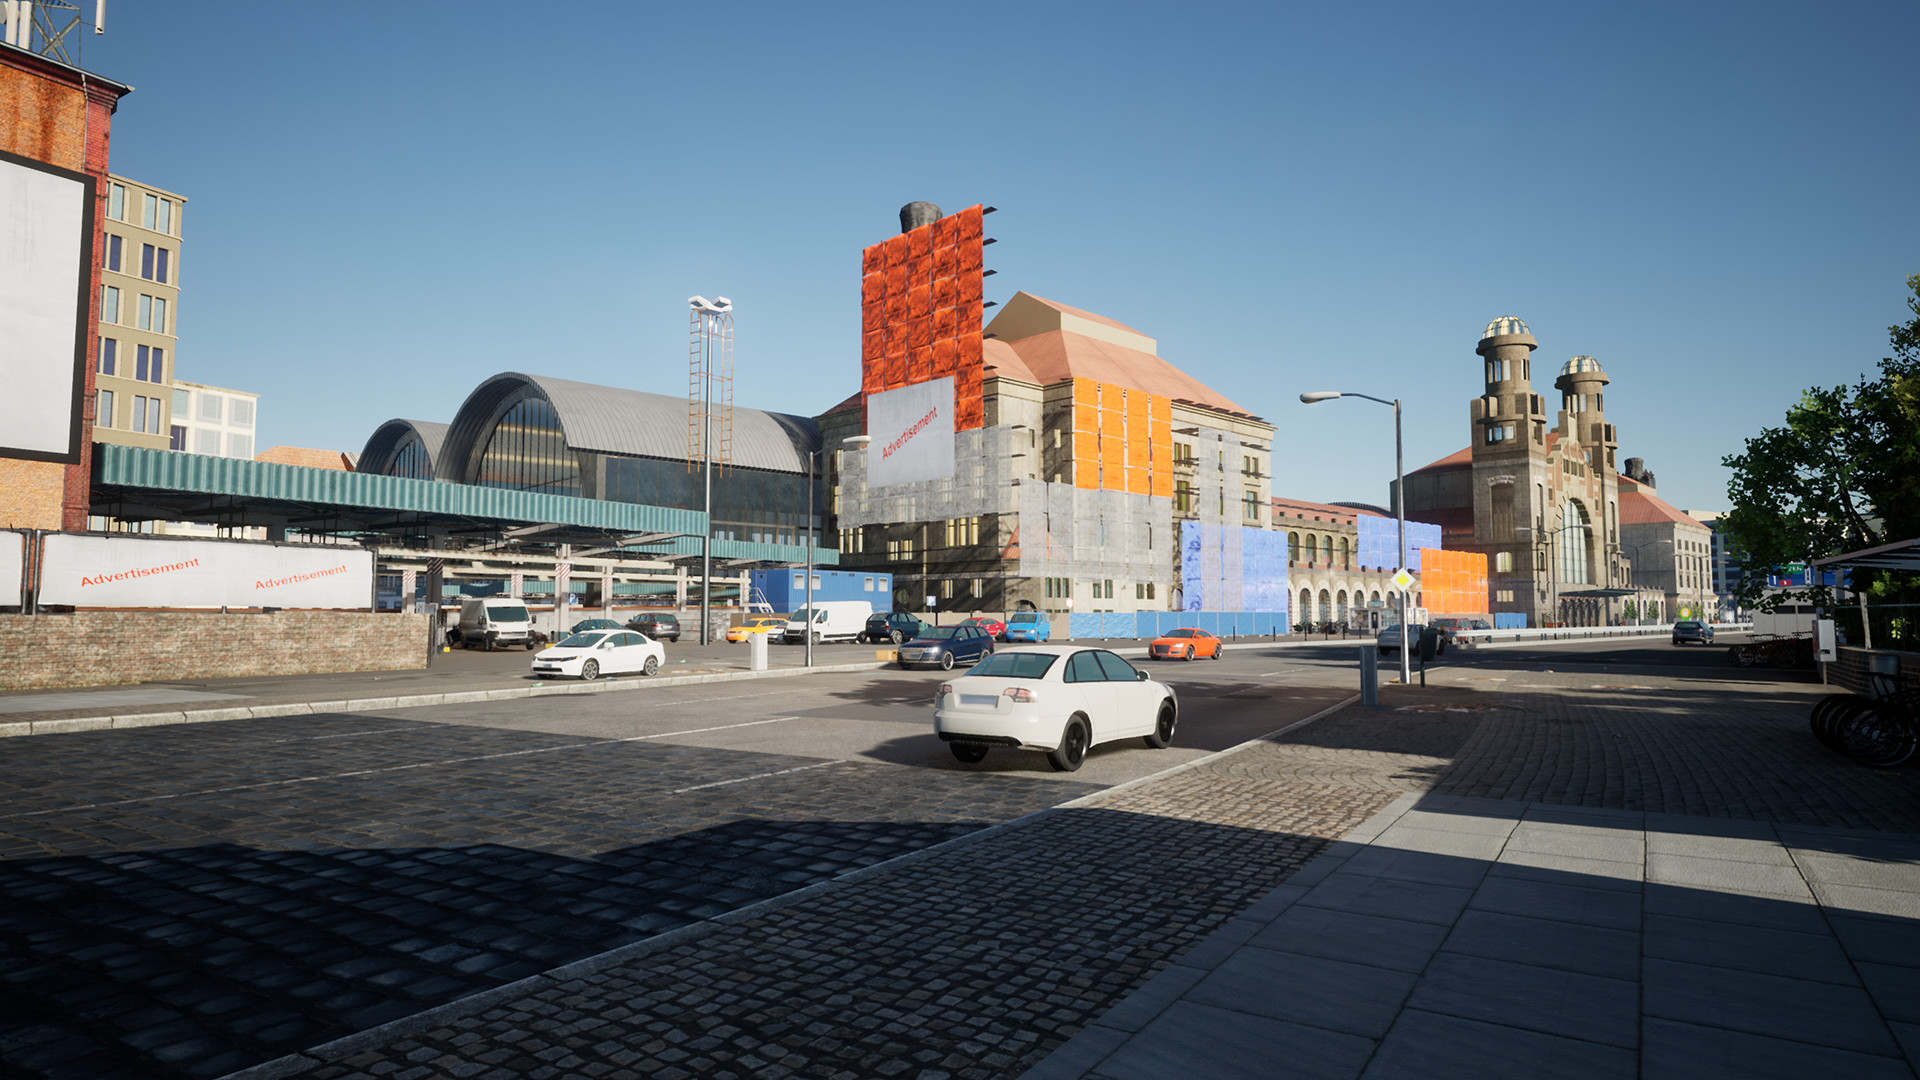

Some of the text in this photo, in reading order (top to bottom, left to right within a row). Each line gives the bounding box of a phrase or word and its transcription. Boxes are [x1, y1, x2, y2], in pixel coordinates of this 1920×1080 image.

[882, 405, 938, 461] Advertisement
[81, 557, 200, 588] Advertisement
[255, 564, 348, 590] Advertisement
